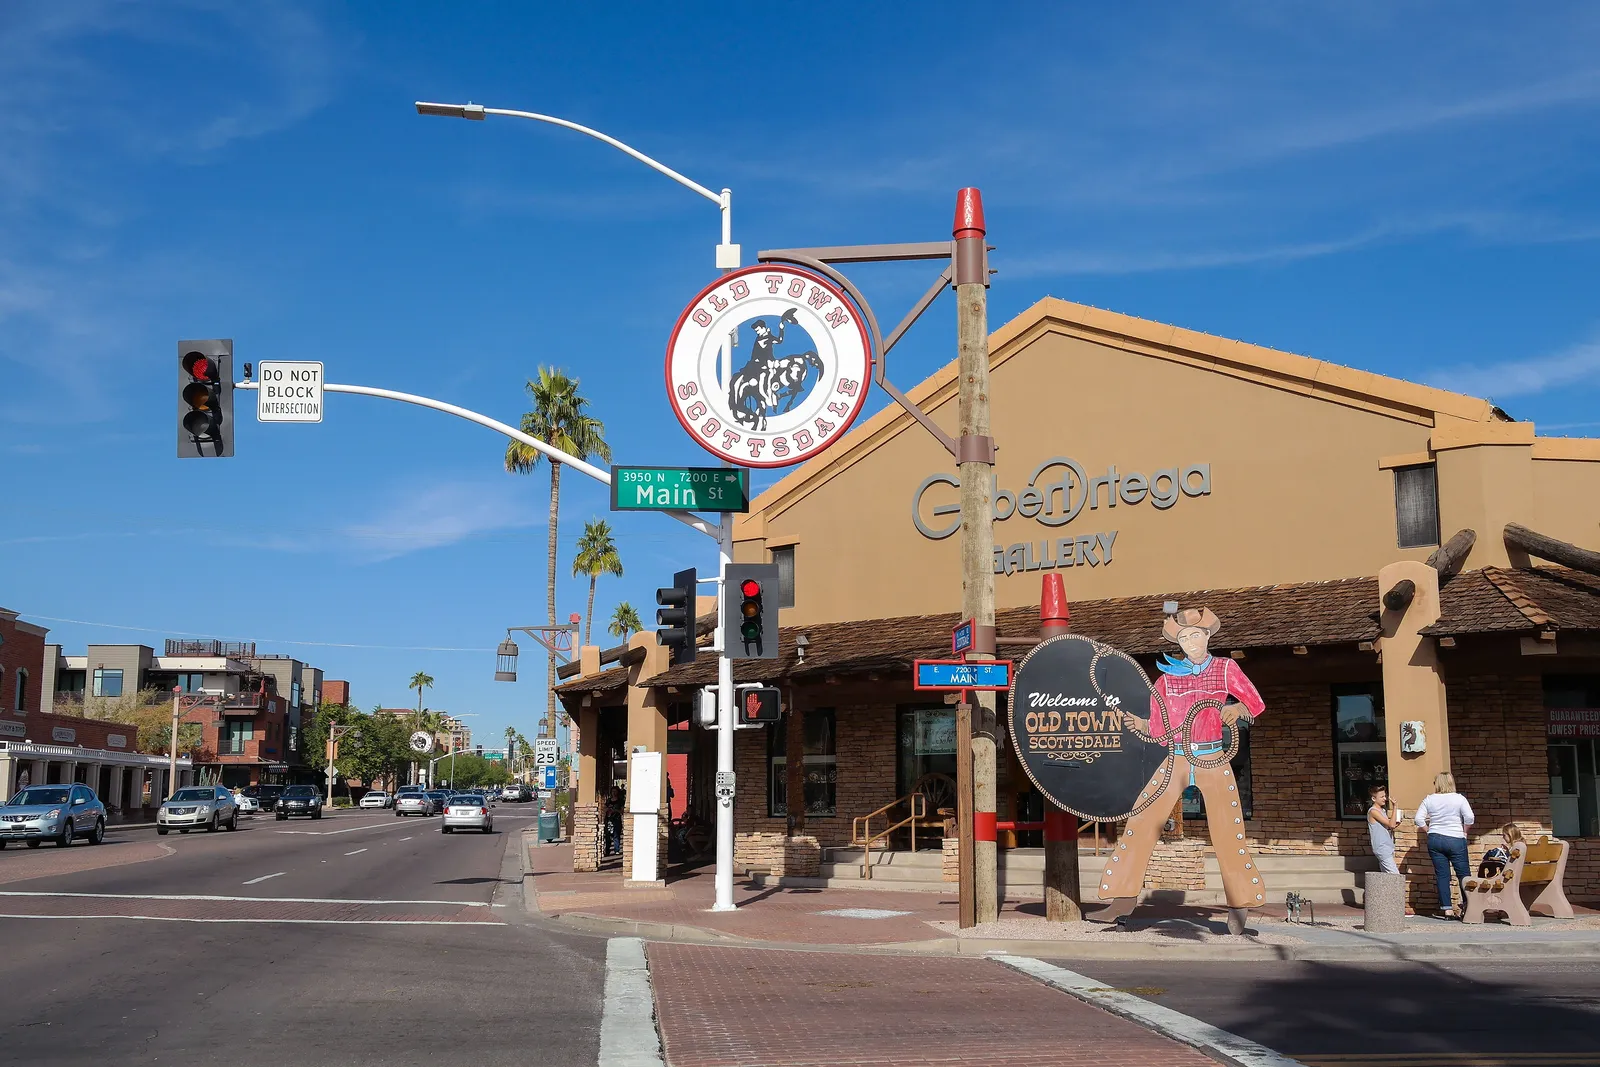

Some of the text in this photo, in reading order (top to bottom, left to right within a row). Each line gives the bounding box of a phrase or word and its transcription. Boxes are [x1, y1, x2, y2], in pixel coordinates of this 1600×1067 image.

[692, 275, 849, 329] OLD TOWN
[263, 369, 318, 381] DO NOT
[267, 386, 314, 398] BLOCK
[262, 402, 319, 414] INTERSECTION
[677, 378, 859, 457] SCOTTSDALE
[623, 472, 720, 482] 3950 N 7200 E
[636, 484, 723, 505] Main St
[950, 674, 978, 684] MAIN
[1028, 692, 1121, 707] Welcome to
[1025, 711, 1123, 733] OLD TOWN
[1547, 724, 1577, 735] LOWEST
[1029, 735, 1121, 749] SCOTTSDALE
[536, 753, 555, 764] 25
